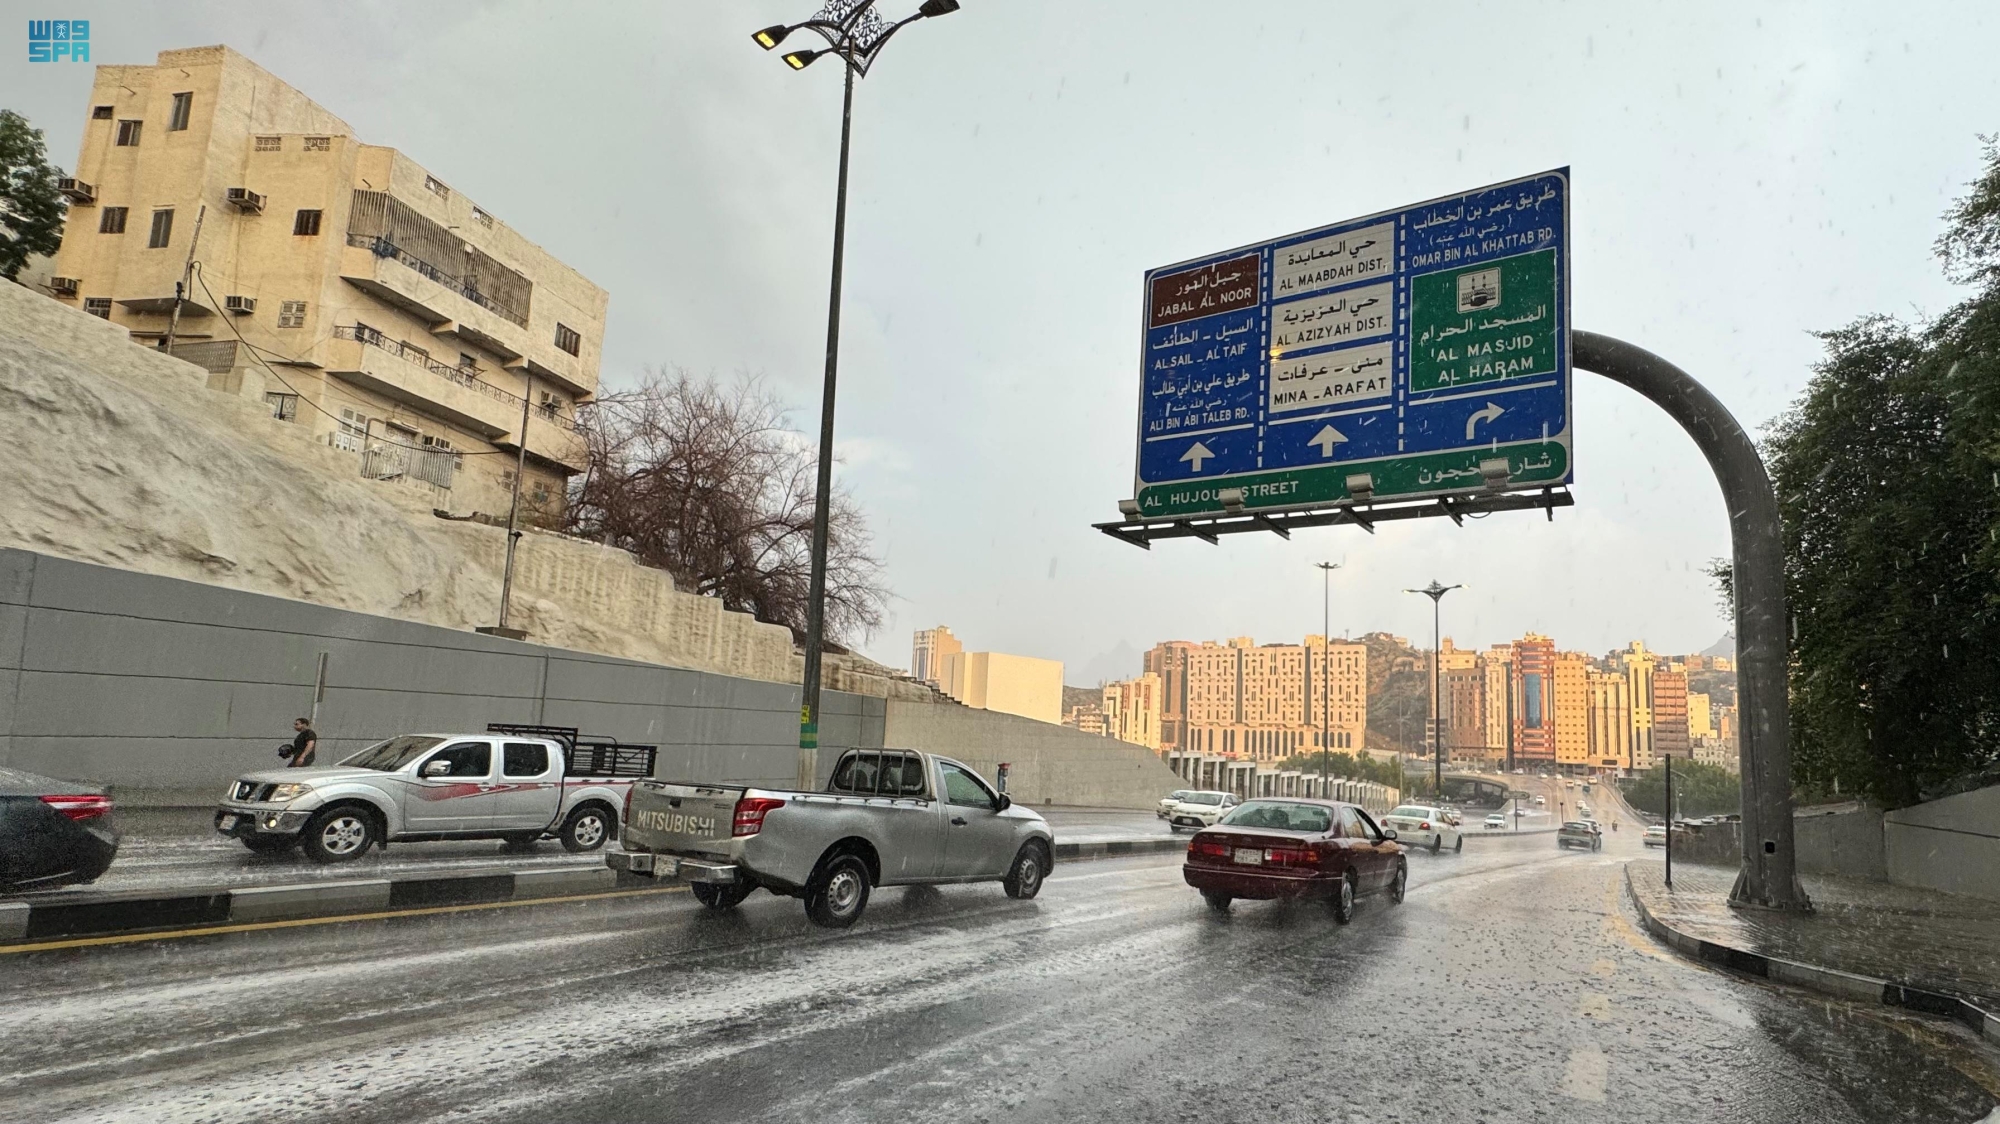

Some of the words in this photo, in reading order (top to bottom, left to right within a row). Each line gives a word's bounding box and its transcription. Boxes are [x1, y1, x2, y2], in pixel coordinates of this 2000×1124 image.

[1486, 200, 1512, 216] عمر
[1516, 184, 1555, 210] طريق
[1413, 206, 1463, 233] الخطاب
[1467, 206, 1481, 221] بن
[1288, 241, 1345, 265] المعابدة
[1350, 240, 1376, 258] حي
[1412, 255, 1440, 267] OMAR
[1444, 248, 1460, 261] BIN
[1464, 244, 1478, 257] AL
[1482, 233, 1534, 254] KHATTAB
[1538, 227, 1556, 245] RD.
[1210, 272, 1241, 288] جبل
[1280, 279, 1293, 291] AL
[1299, 264, 1353, 286] MAABDAH
[1158, 301, 1194, 317] JABAL
[1200, 296, 1215, 308] AL
[1220, 288, 1252, 303] NOOR
[1283, 298, 1345, 324] العزيزية
[1350, 298, 1379, 316] حي
[1216, 318, 1253, 341] السيل
[1479, 304, 1546, 330] المسجد
[1153, 329, 1198, 349] الطائف
[1276, 334, 1290, 346] AL
[1297, 323, 1350, 343] AZIZYAH
[1357, 317, 1387, 332] DIST.
[1420, 318, 1473, 347] الحرام
[1155, 360, 1168, 370] AL
[1171, 354, 1193, 367] SAIL
[1206, 348, 1220, 360] AL
[1223, 343, 1247, 357] TAIF
[1437, 348, 1458, 362] AL
[1467, 335, 1533, 357] MASJID
[1224, 368, 1250, 388] طريق
[1278, 363, 1328, 381] عرفات
[1352, 357, 1382, 373] منى
[1438, 369, 1460, 383] AL
[1469, 356, 1533, 377] HARAM
[1192, 380, 1202, 392] بن
[1204, 374, 1222, 394] علي
[1274, 390, 1307, 405] MINA
[1324, 377, 1386, 397] ARAFAT
[1150, 420, 1163, 431] ALI
[1166, 417, 1180, 429] BIN
[1184, 415, 1198, 426] ABI
[1203, 409, 1231, 424] TALEB
[1235, 408, 1249, 419] RD.
[1508, 452, 1551, 480] شار
[1145, 496, 1162, 508] AL
[1171, 490, 1220, 505] HUJOU
[1242, 481, 1299, 497] STREET
[638, 810, 714, 836] MITSUBISHI
